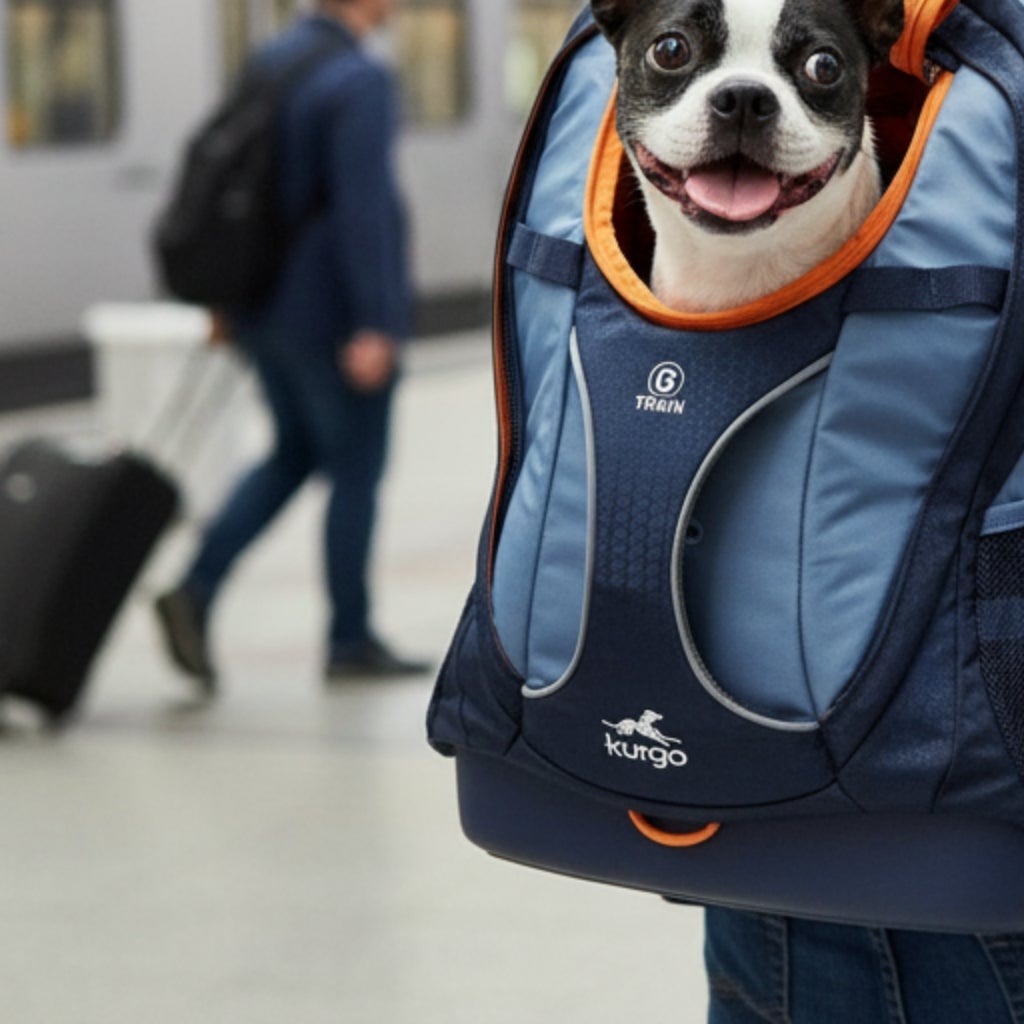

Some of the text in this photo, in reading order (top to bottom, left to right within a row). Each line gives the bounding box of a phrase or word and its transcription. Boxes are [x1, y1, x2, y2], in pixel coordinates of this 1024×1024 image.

[655, 368, 677, 393] G
[635, 395, 686, 414] TRAIN
[604, 732, 688, 769] kurgo
